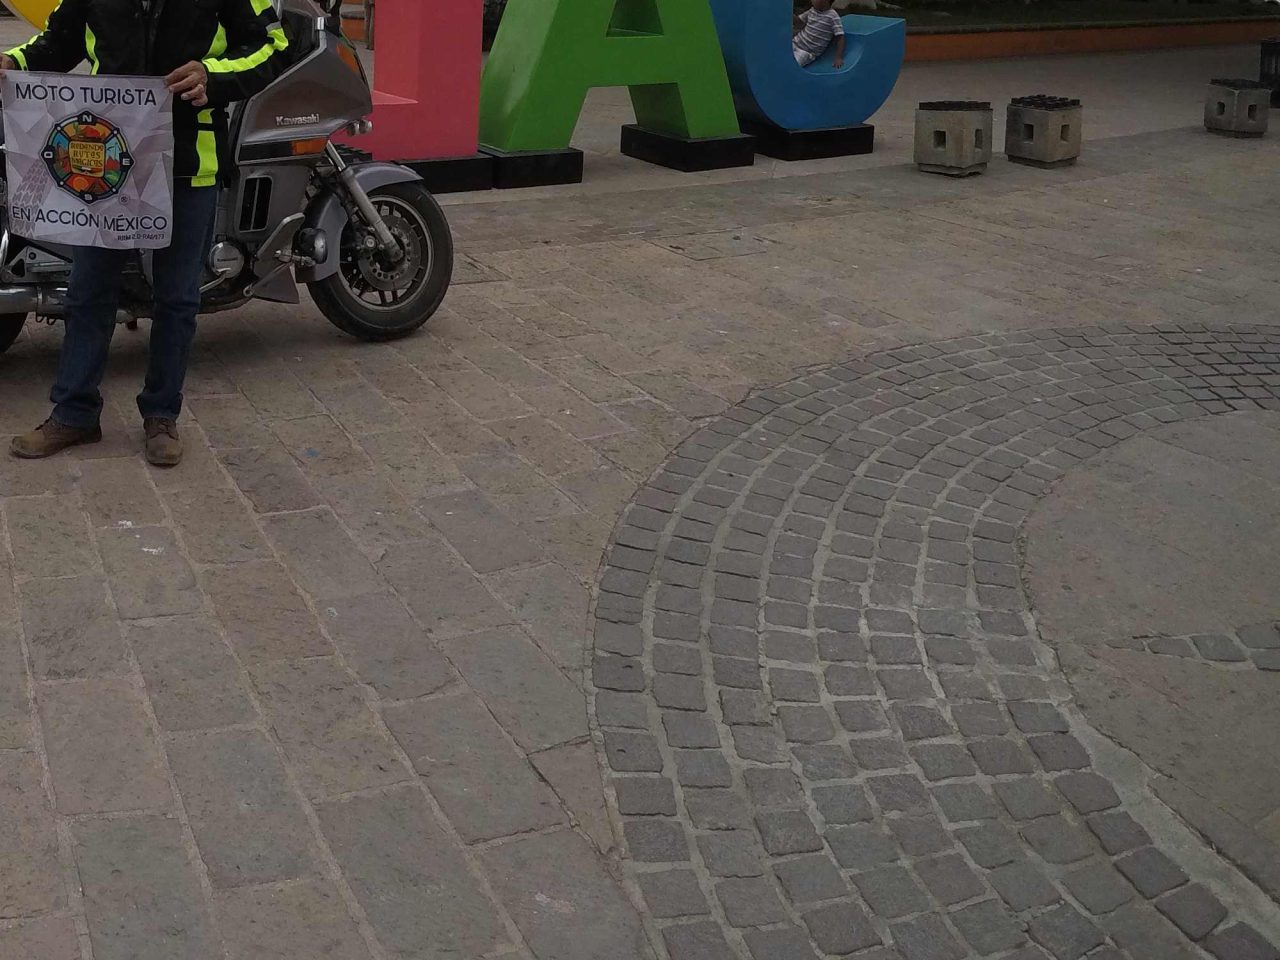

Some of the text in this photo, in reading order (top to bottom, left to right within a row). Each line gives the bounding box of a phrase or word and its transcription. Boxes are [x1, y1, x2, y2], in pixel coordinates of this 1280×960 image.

[15, 83, 157, 106] MOTO TURISTA
[82, 115, 92, 123] N
[275, 113, 320, 126] Kawasaki
[122, 158, 131, 166] E
[12, 205, 168, 232] EN ACCIÓN MÉXICO
